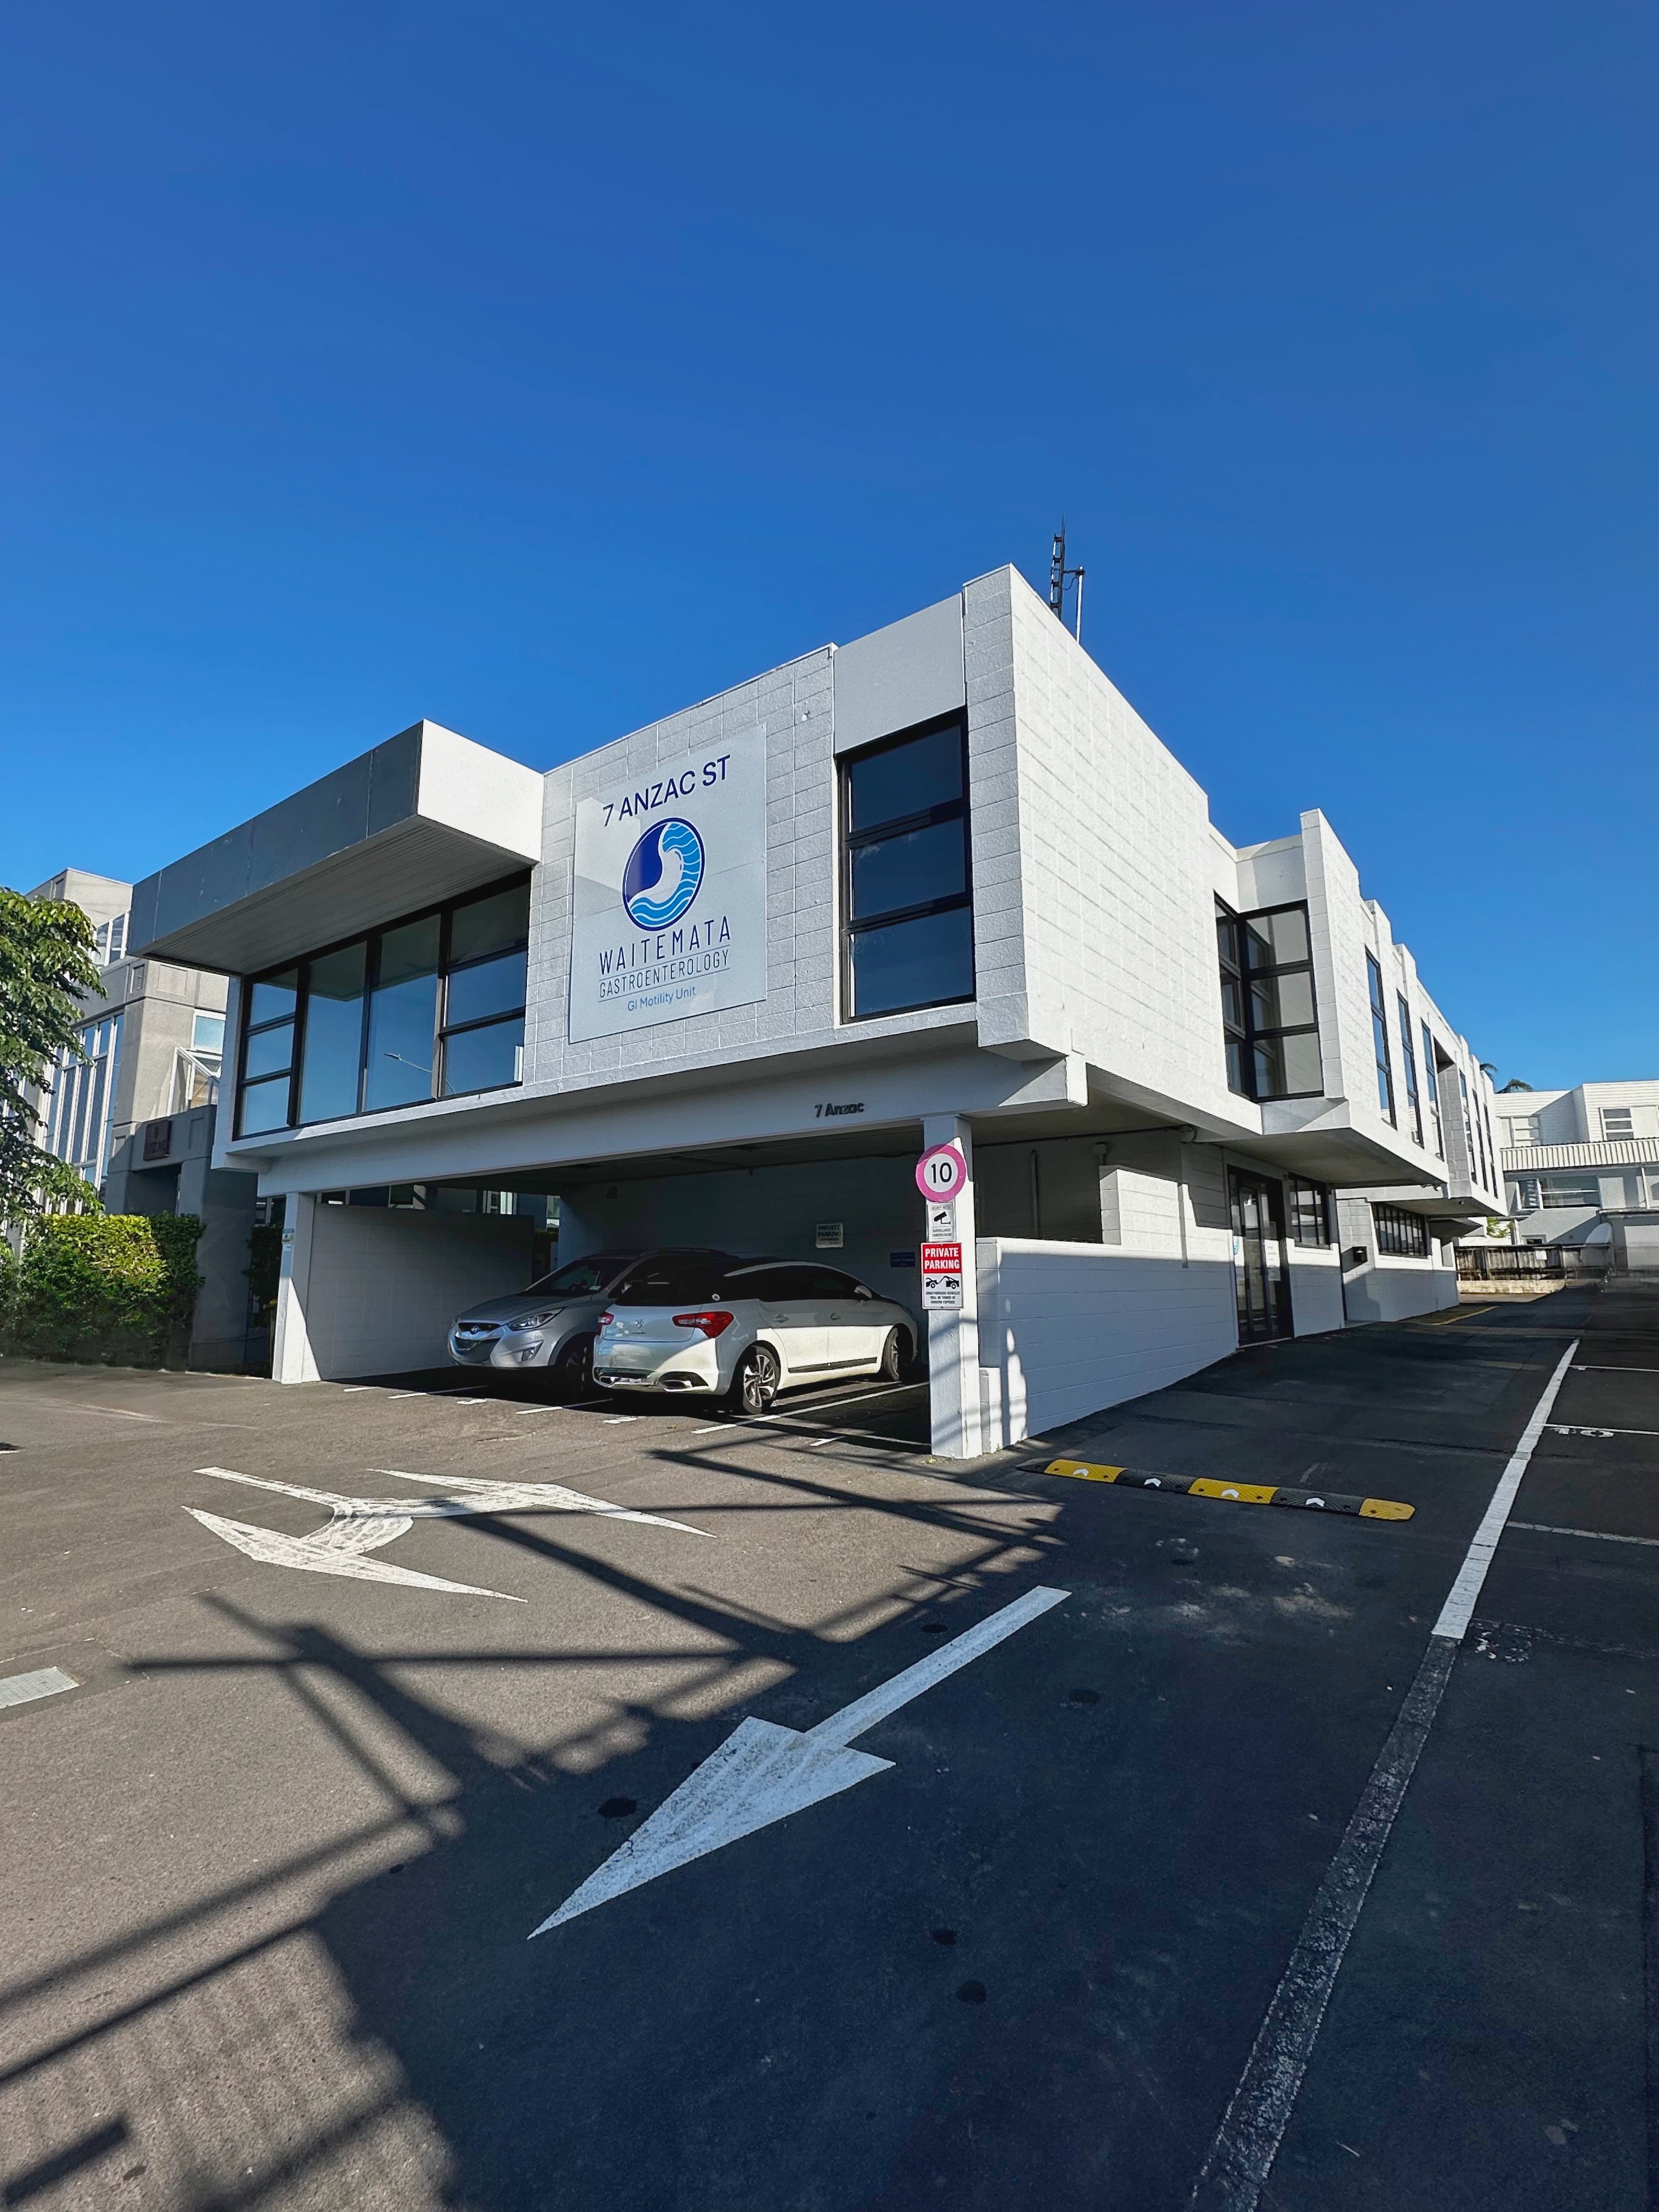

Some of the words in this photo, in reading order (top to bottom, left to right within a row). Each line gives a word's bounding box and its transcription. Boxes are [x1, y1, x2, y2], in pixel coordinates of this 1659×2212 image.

[602, 803, 614, 827] 7
[618, 770, 696, 821] ANZAC
[702, 754, 731, 786] ST
[599, 916, 730, 975] WAITEMATA
[600, 949, 729, 998] GASTROENTEROLOGY
[628, 1000, 637, 1011] GI
[640, 993, 674, 1008] Motility
[676, 986, 696, 1000] Unit
[815, 1104, 823, 1118] 7
[825, 1103, 864, 1116] Anzac
[931, 1162, 952, 1184] 10
[924, 1259, 960, 1269] PARKING
[925, 1248, 959, 1257] PRIVATE
